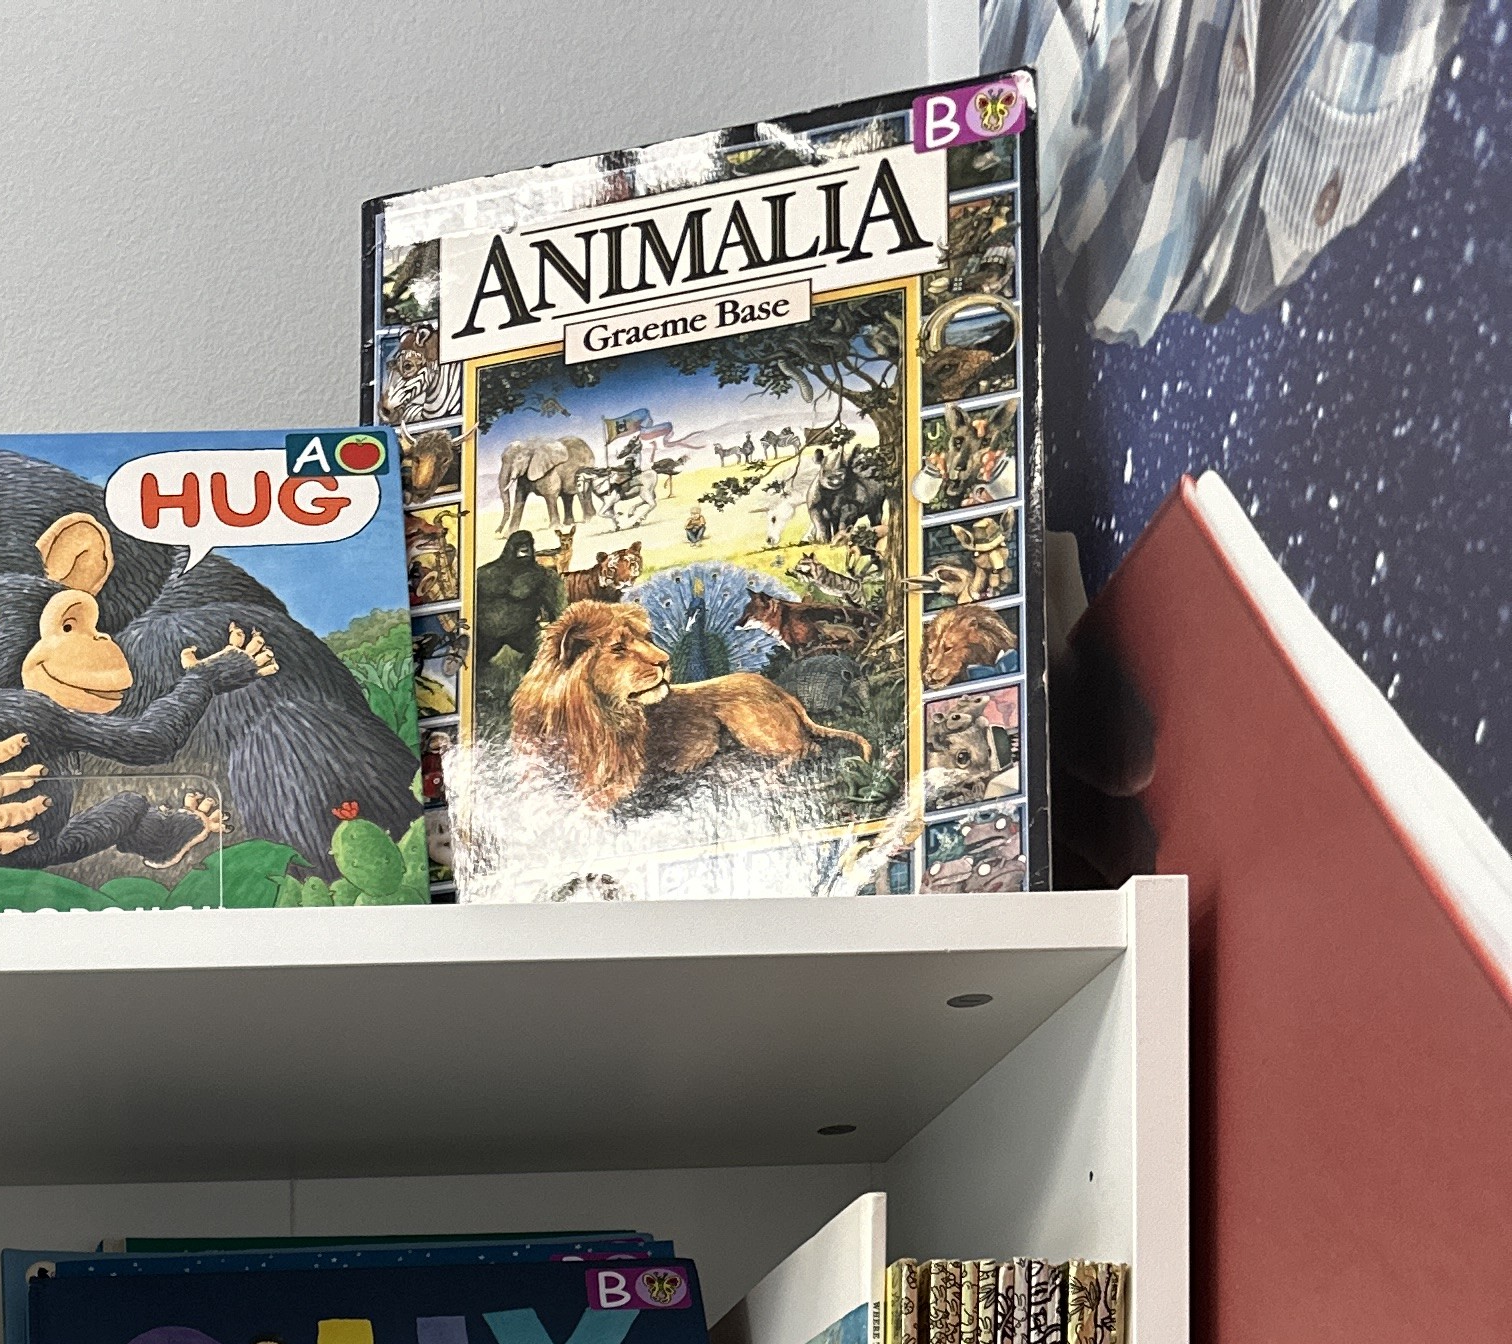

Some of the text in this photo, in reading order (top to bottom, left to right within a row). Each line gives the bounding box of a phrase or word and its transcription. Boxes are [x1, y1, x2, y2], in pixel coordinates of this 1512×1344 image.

[924, 96, 958, 148] B
[451, 158, 931, 338] ANIMALIA
[583, 296, 789, 353] Graeme Base
[293, 436, 328, 473] A
[139, 471, 351, 529] HUG
[599, 1274, 631, 1307] B
[872, 1302, 880, 1339] WHERE
